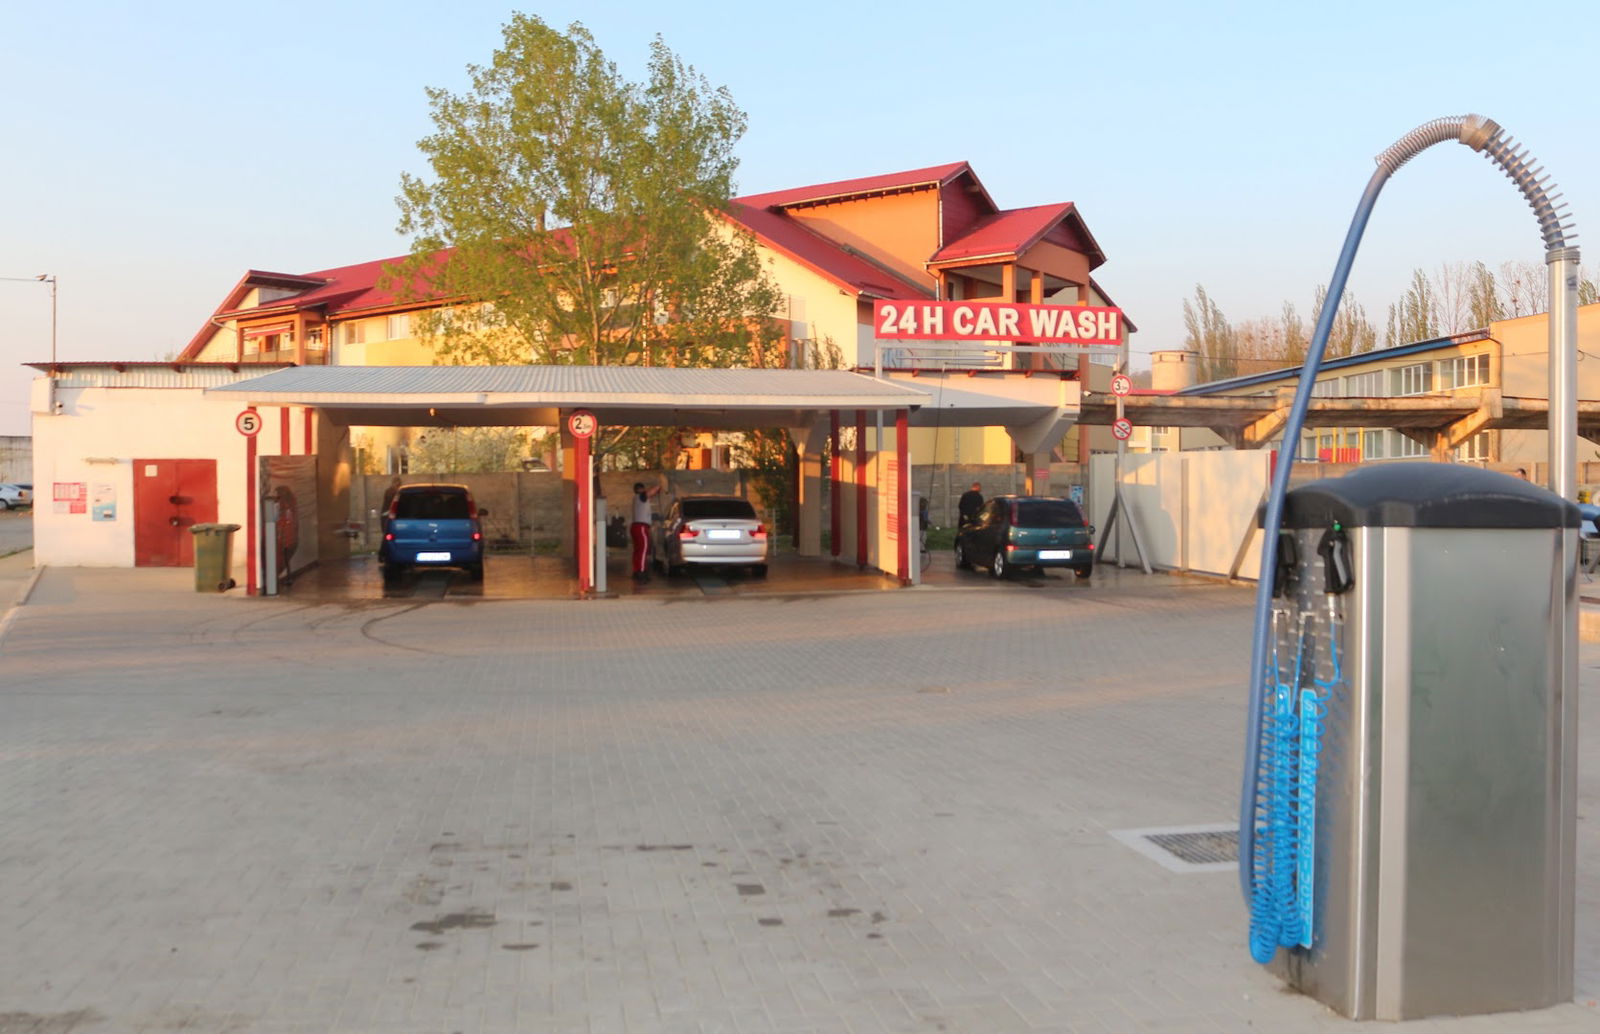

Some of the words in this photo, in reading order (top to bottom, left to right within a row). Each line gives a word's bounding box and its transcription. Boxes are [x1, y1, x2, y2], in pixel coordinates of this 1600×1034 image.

[953, 306, 1021, 336] CAR
[1029, 309, 1117, 340] WASH
[244, 417, 254, 430] 5
